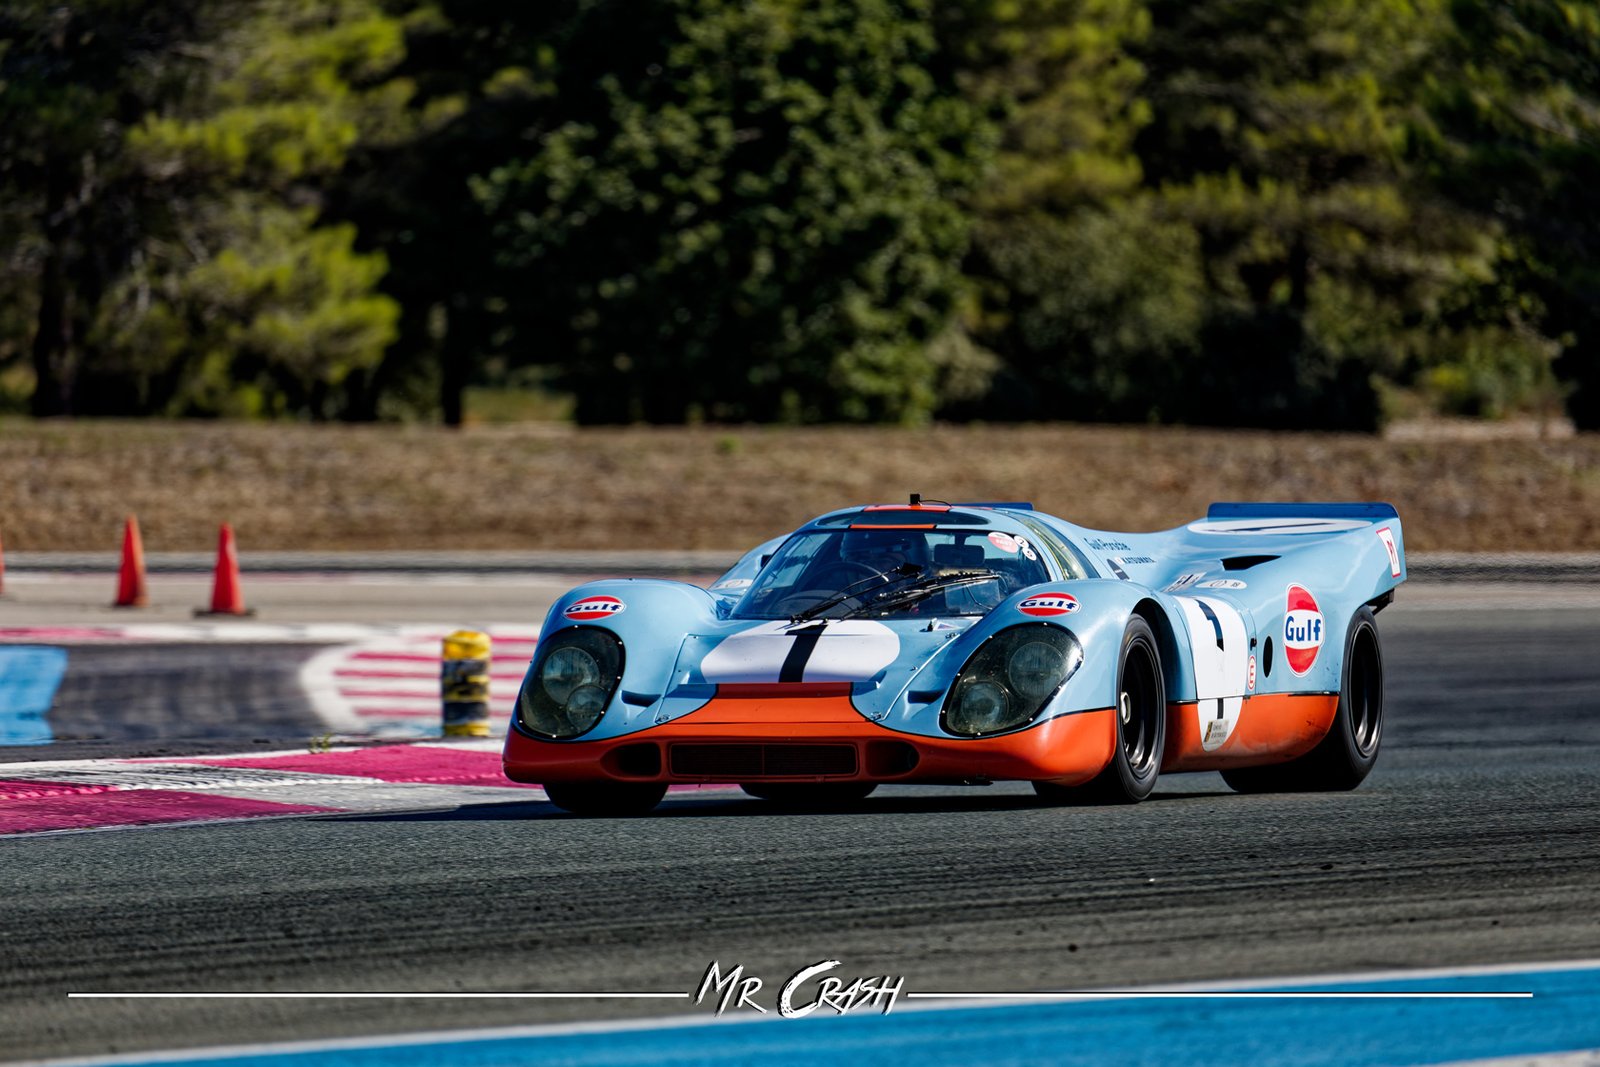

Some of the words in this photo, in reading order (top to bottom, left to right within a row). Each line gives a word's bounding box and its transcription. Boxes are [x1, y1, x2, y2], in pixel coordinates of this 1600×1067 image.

[565, 603, 622, 613] Gulf
[1019, 600, 1078, 610] Gulf
[1285, 615, 1322, 642] Gulf
[778, 624, 829, 683] 1
